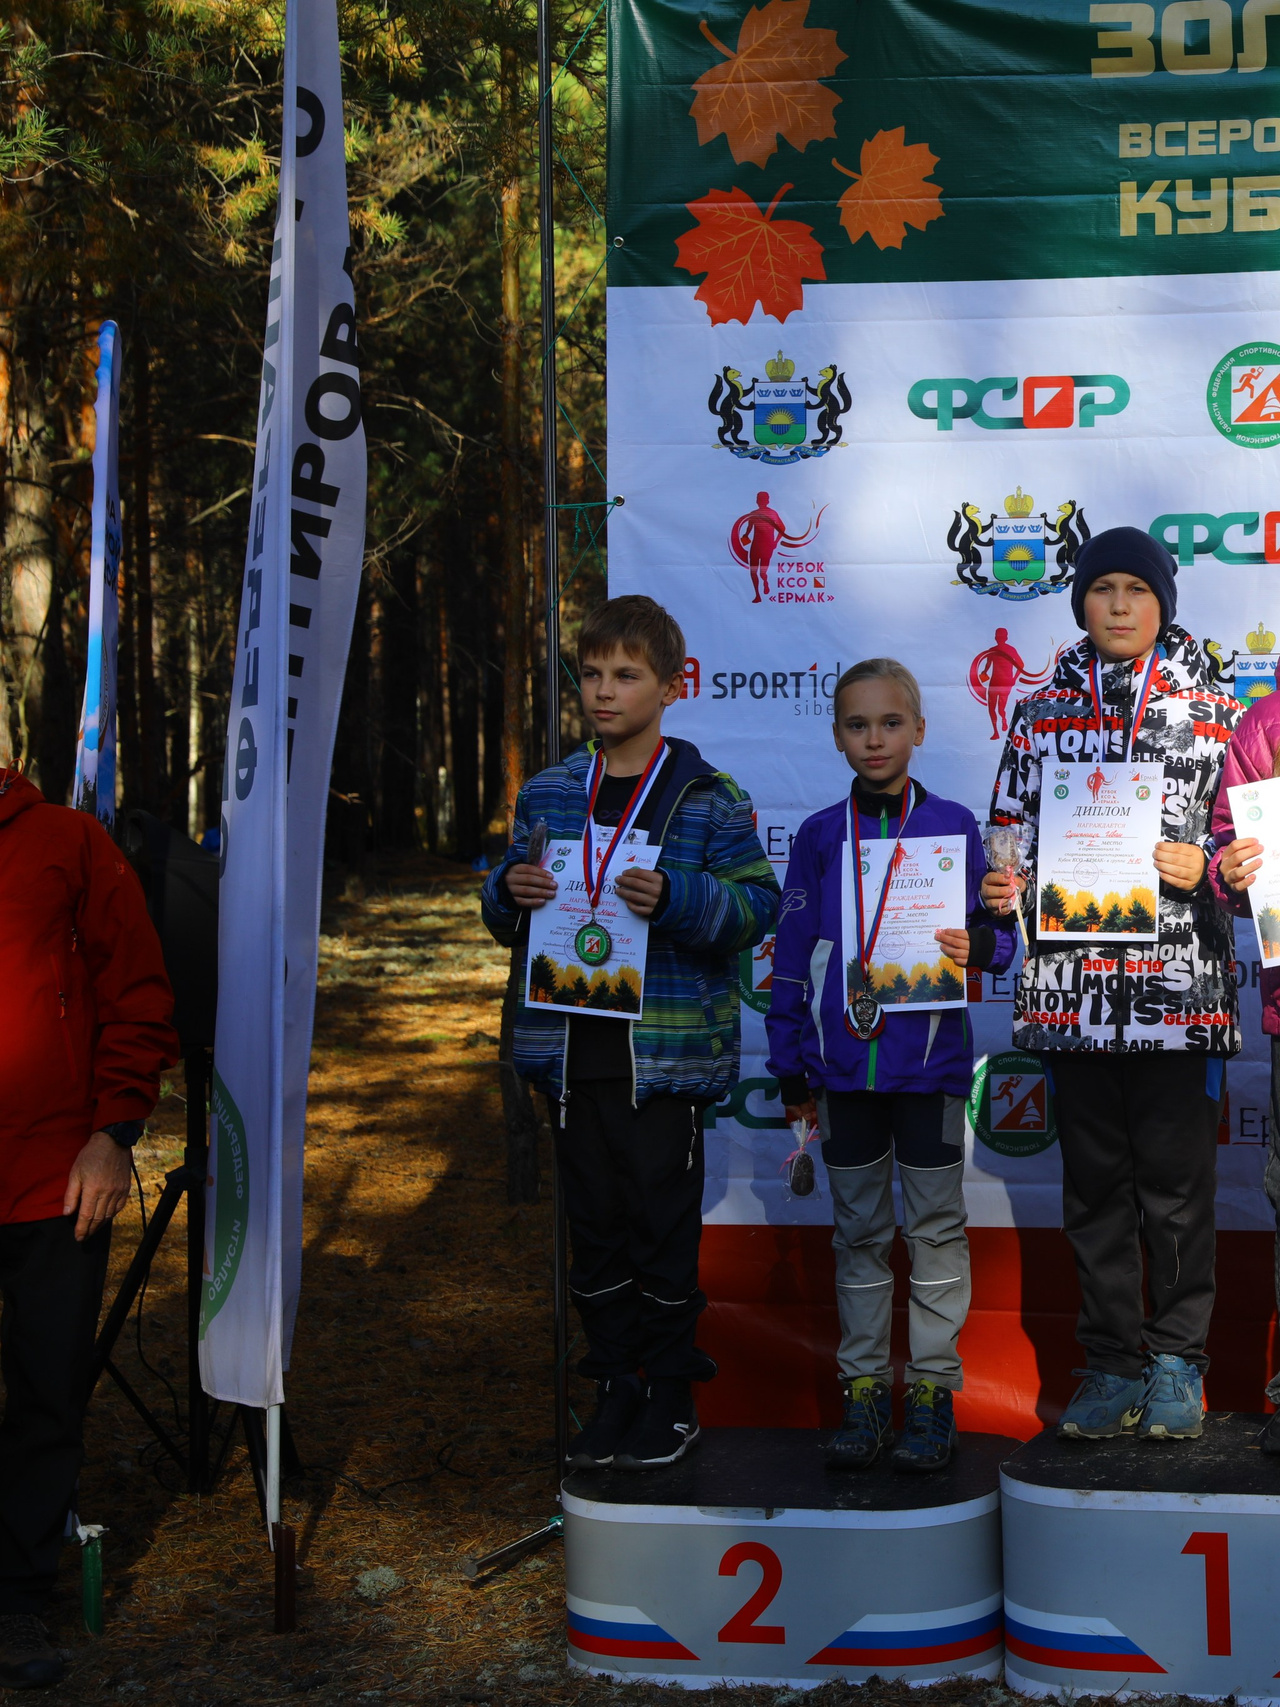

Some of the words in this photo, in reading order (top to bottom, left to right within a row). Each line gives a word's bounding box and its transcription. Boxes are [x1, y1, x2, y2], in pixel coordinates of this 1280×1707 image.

[777, 562, 825, 573] КУБОК
[777, 577, 808, 588] КСО
[769, 592, 835, 604] «ЕРМАК»
[712, 662, 841, 699] SPORTid
[794, 700, 835, 716] sibe
[1072, 806, 1131, 818] ДИПЛОМ
[875, 878, 934, 891] ИПЛОМ
[717, 1541, 786, 1645] 2
[1180, 1531, 1231, 1657] 1
